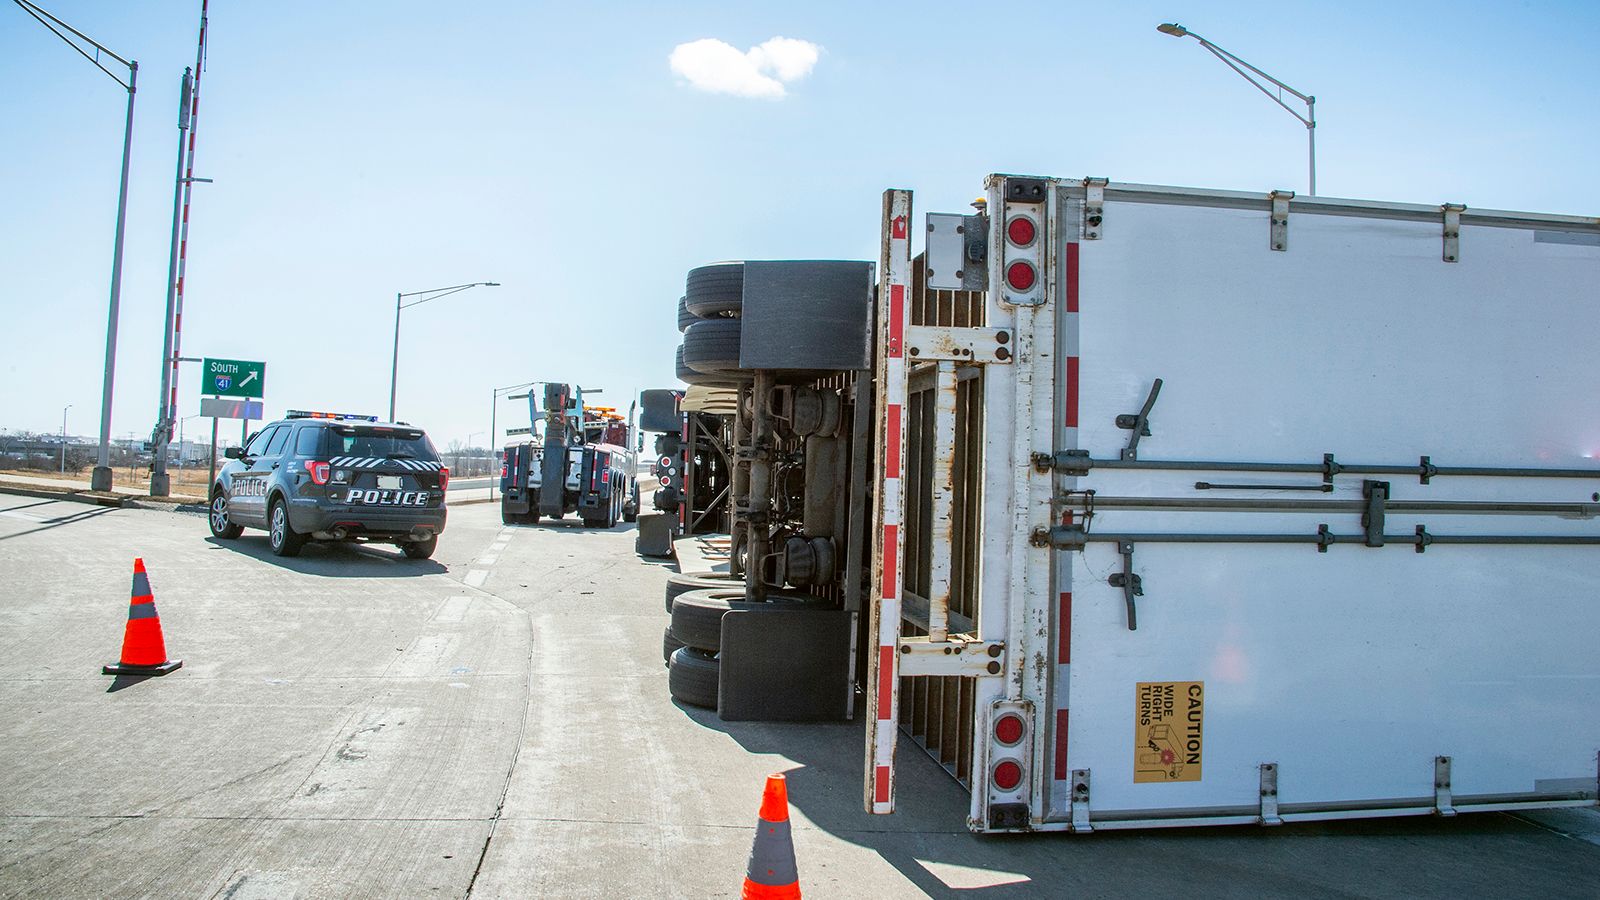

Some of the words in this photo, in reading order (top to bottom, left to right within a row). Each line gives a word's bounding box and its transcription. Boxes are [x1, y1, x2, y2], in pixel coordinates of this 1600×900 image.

[210, 362, 239, 373] SOUTH
[218, 379, 228, 388] 41
[234, 479, 267, 497] POLICE
[346, 489, 428, 506] POLICE
[1141, 685, 1151, 726] TURNS
[1152, 685, 1162, 721] RIGHT
[1163, 684, 1174, 717] WIDE
[1186, 684, 1202, 764] CAUTION
